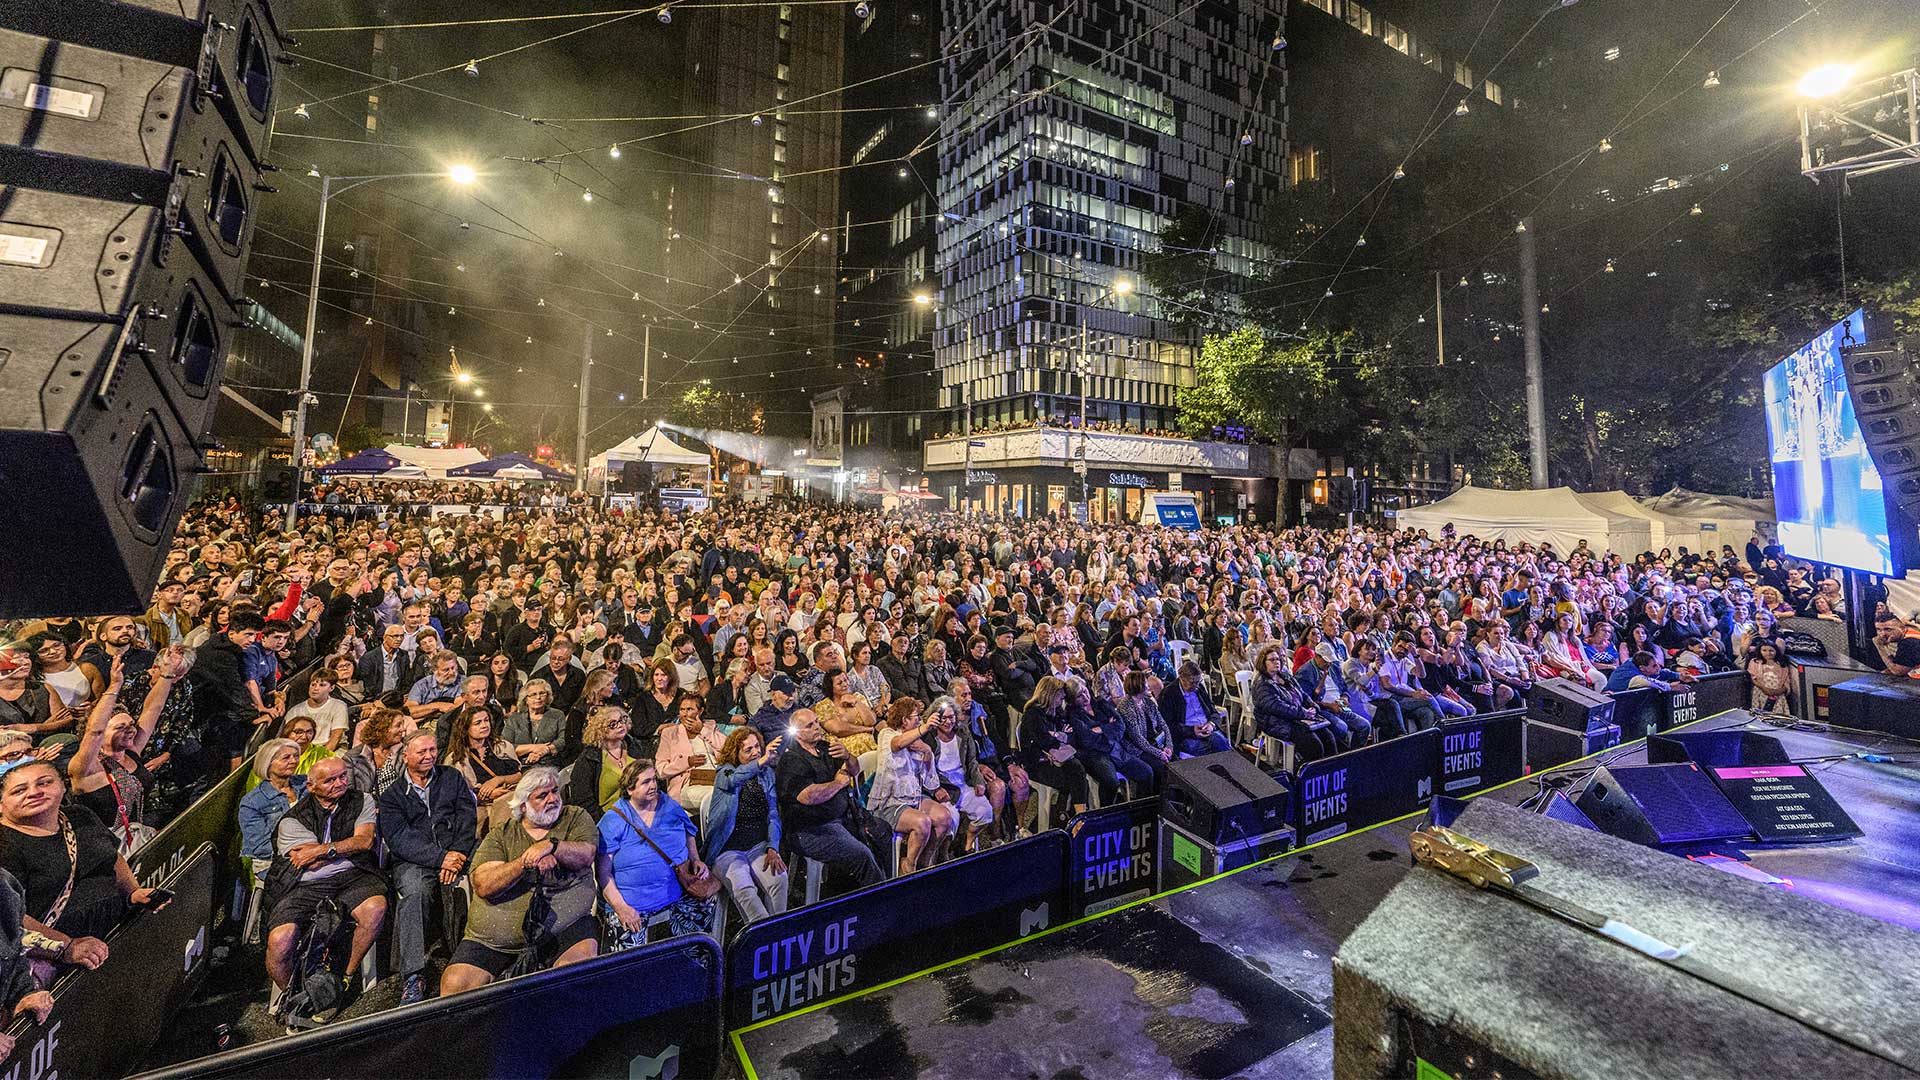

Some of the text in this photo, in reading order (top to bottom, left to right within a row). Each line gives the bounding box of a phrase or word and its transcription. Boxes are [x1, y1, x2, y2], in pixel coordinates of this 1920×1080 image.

[1673, 692, 1696, 708] CITY OF
[1673, 707, 1697, 724] EVENTS
[1444, 731, 1482, 753] CITY OF
[1444, 751, 1482, 774] EVENTS
[1305, 768, 1348, 801] CITY OF
[1305, 792, 1348, 826] EVENTS
[1085, 823, 1152, 862] CITY OF
[1084, 851, 1151, 893] EVENTS
[753, 915, 858, 980] CITY OF
[751, 953, 856, 1022] EVENTS
[30, 1020, 61, 1080] OF
